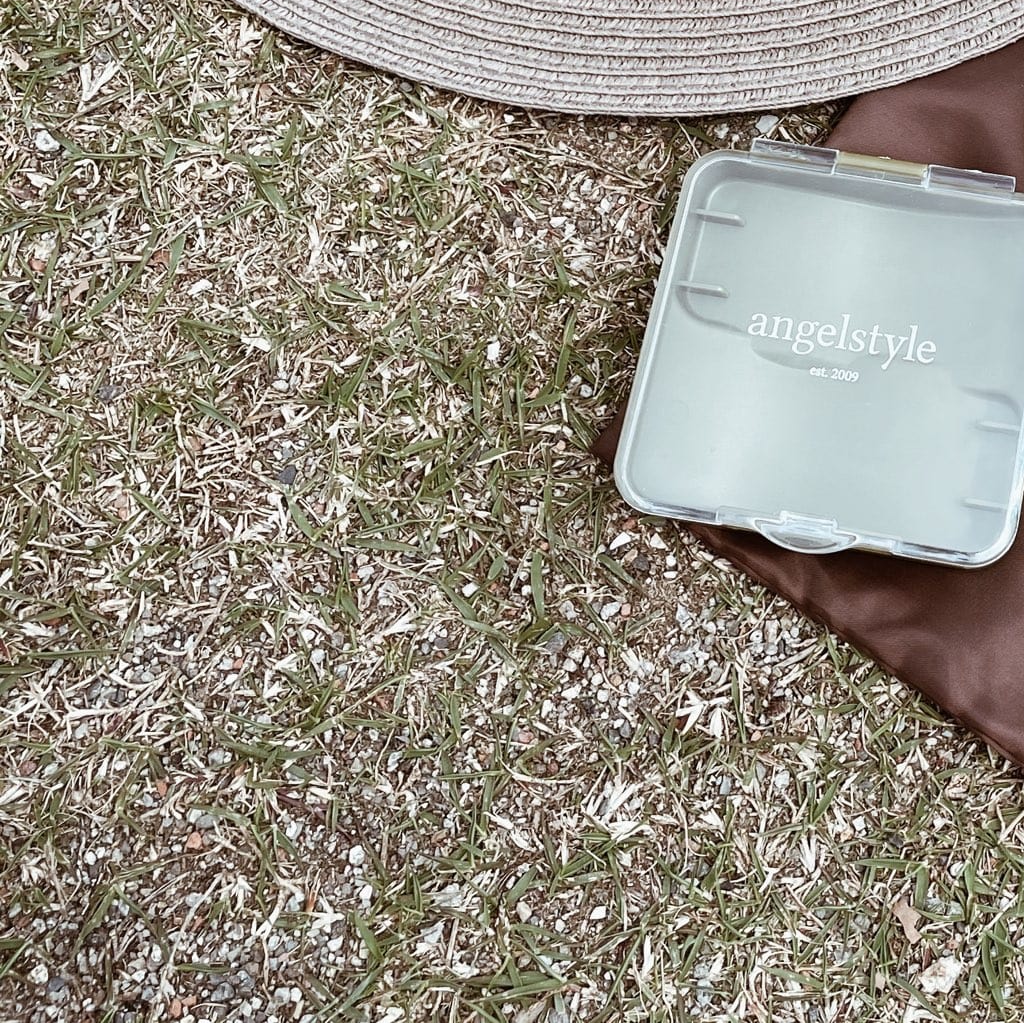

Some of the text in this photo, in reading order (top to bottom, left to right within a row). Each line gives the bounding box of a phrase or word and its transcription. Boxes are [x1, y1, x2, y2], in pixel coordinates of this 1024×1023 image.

[747, 312, 937, 370] angelstyle
[809, 366, 860, 382] est. 2009
